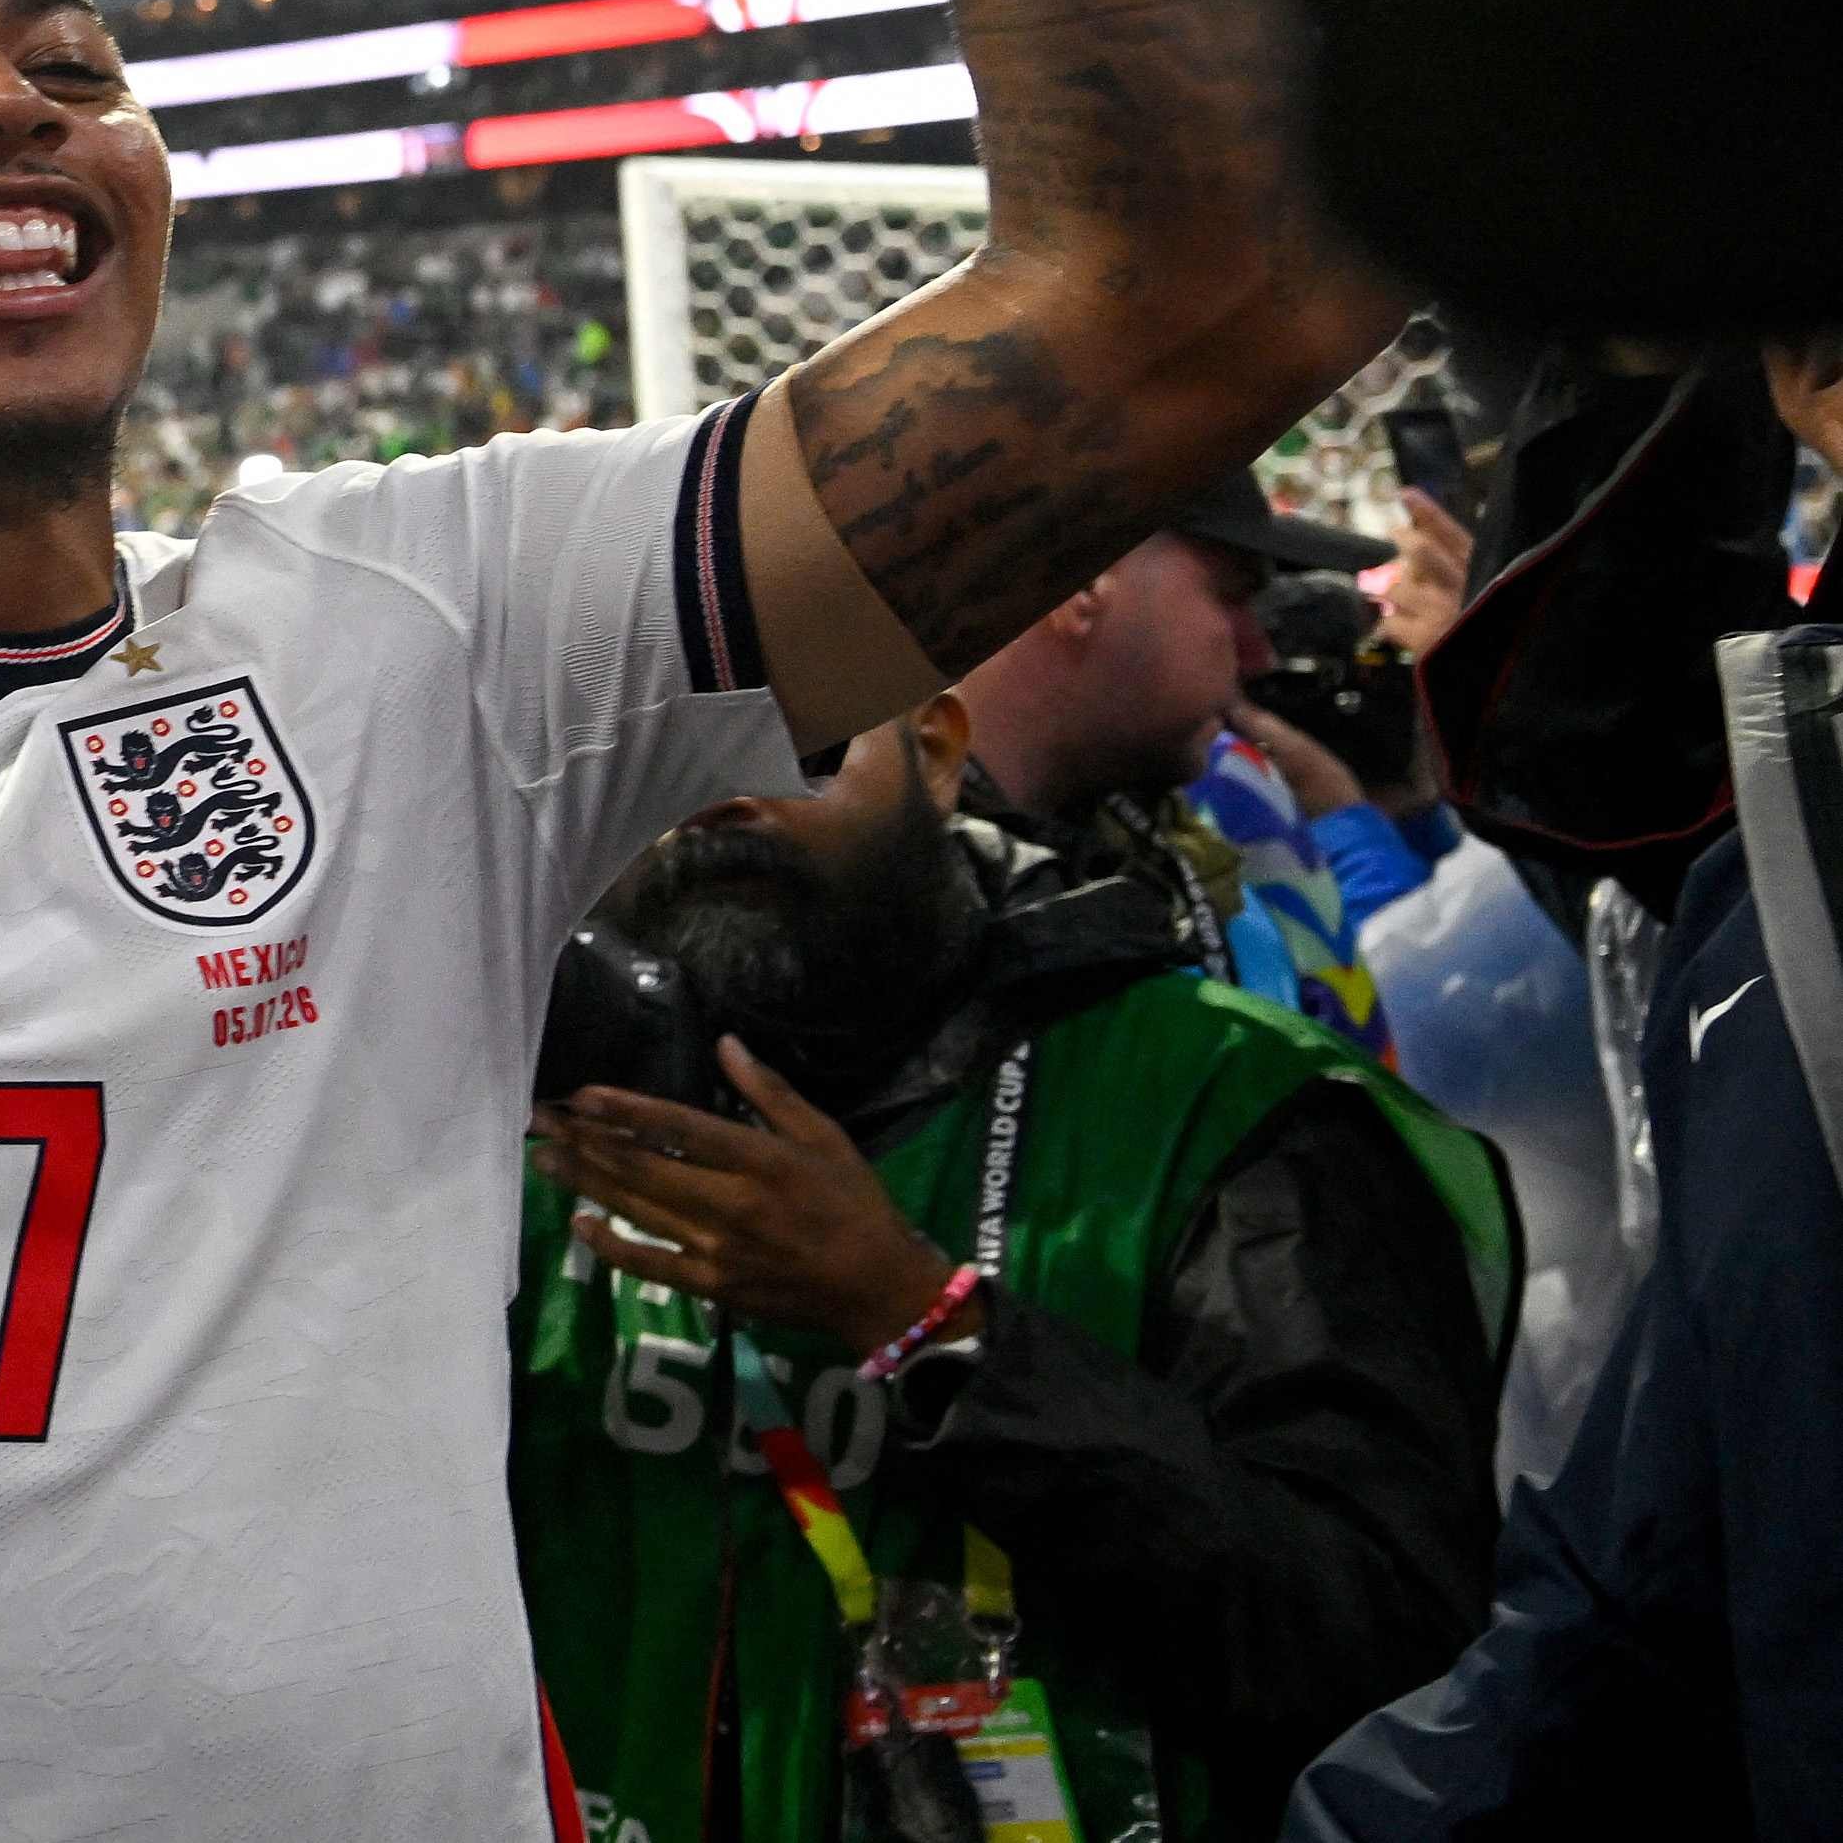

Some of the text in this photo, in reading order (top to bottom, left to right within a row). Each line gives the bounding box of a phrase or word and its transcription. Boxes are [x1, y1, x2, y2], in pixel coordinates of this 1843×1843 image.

[196, 934, 308, 991] MEXICO
[213, 985, 320, 1048] 05.07.26
[995, 1060, 1027, 1113] CUP
[982, 1115, 1018, 1214] WORLD
